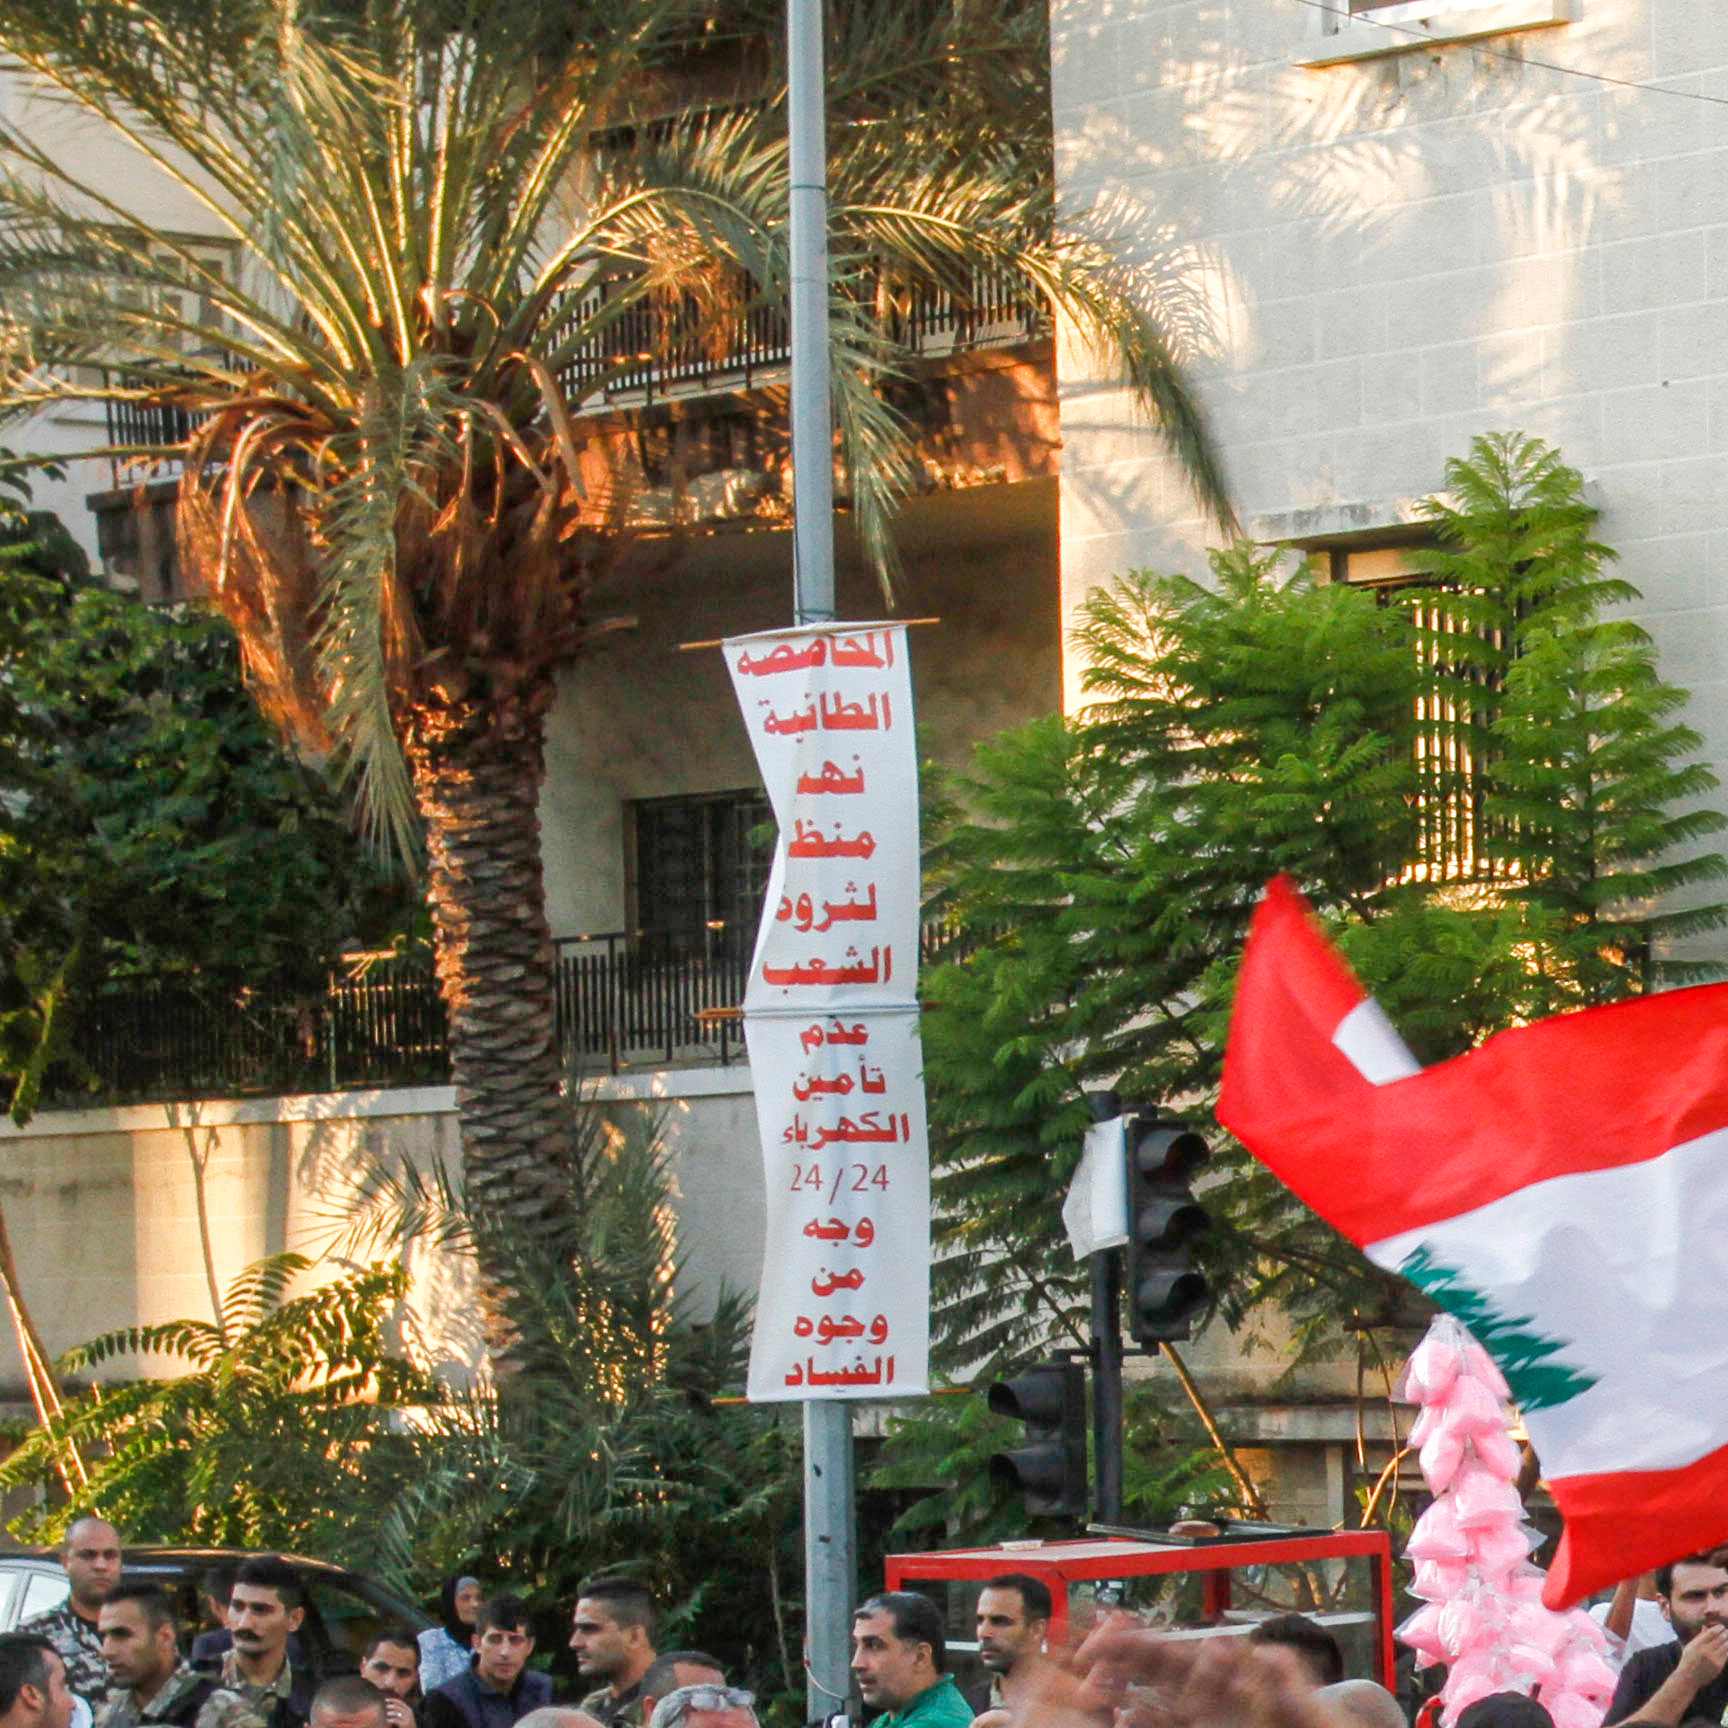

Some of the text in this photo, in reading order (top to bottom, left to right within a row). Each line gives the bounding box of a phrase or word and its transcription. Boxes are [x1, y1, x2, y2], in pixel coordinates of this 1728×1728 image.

[788, 819, 878, 861] منظ
[762, 944, 893, 995] الشعب
[799, 1020, 870, 1056] عدم
[792, 1053, 887, 1102] تأمين
[781, 1110, 911, 1151] الكهرباء
[803, 1216, 876, 1249] وجه
[811, 1266, 866, 1298] من
[793, 1313, 889, 1346] وجوه
[784, 1354, 896, 1387] الفساد
